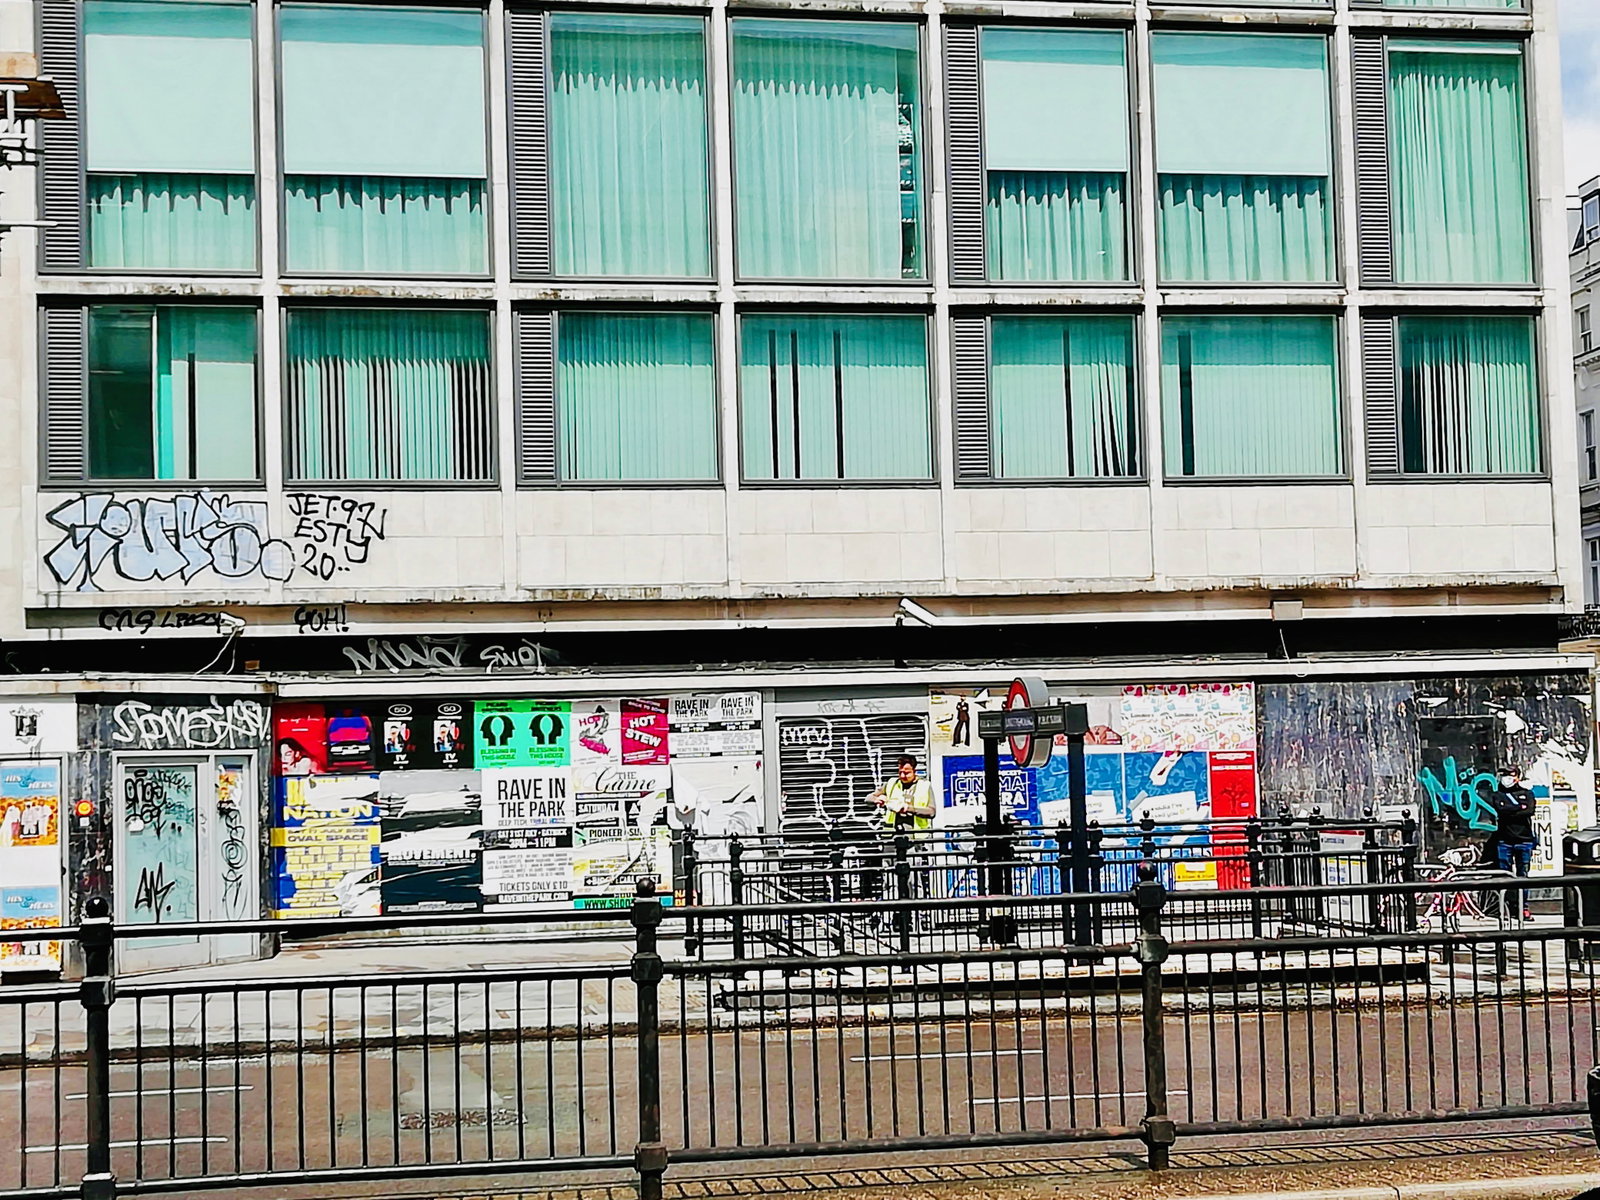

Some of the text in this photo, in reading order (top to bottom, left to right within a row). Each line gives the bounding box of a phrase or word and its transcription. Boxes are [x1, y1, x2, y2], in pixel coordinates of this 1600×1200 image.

[674, 698, 709, 710] RAVE IN
[720, 695, 754, 708] RAVE IN
[676, 708, 709, 718] THE PARK
[722, 706, 754, 717] THE PARK
[628, 714, 657, 730] HOT
[624, 728, 663, 747] STEW
[594, 766, 657, 793] Game
[617, 771, 637, 780] THE
[27, 779, 57, 791] HERS
[497, 777, 566, 801] RAVE IN
[954, 777, 1025, 794] CINMA
[498, 800, 566, 818] THE PARK
[589, 828, 623, 838] PIONEER
[499, 880, 568, 892] TICKETS ONLY £10
